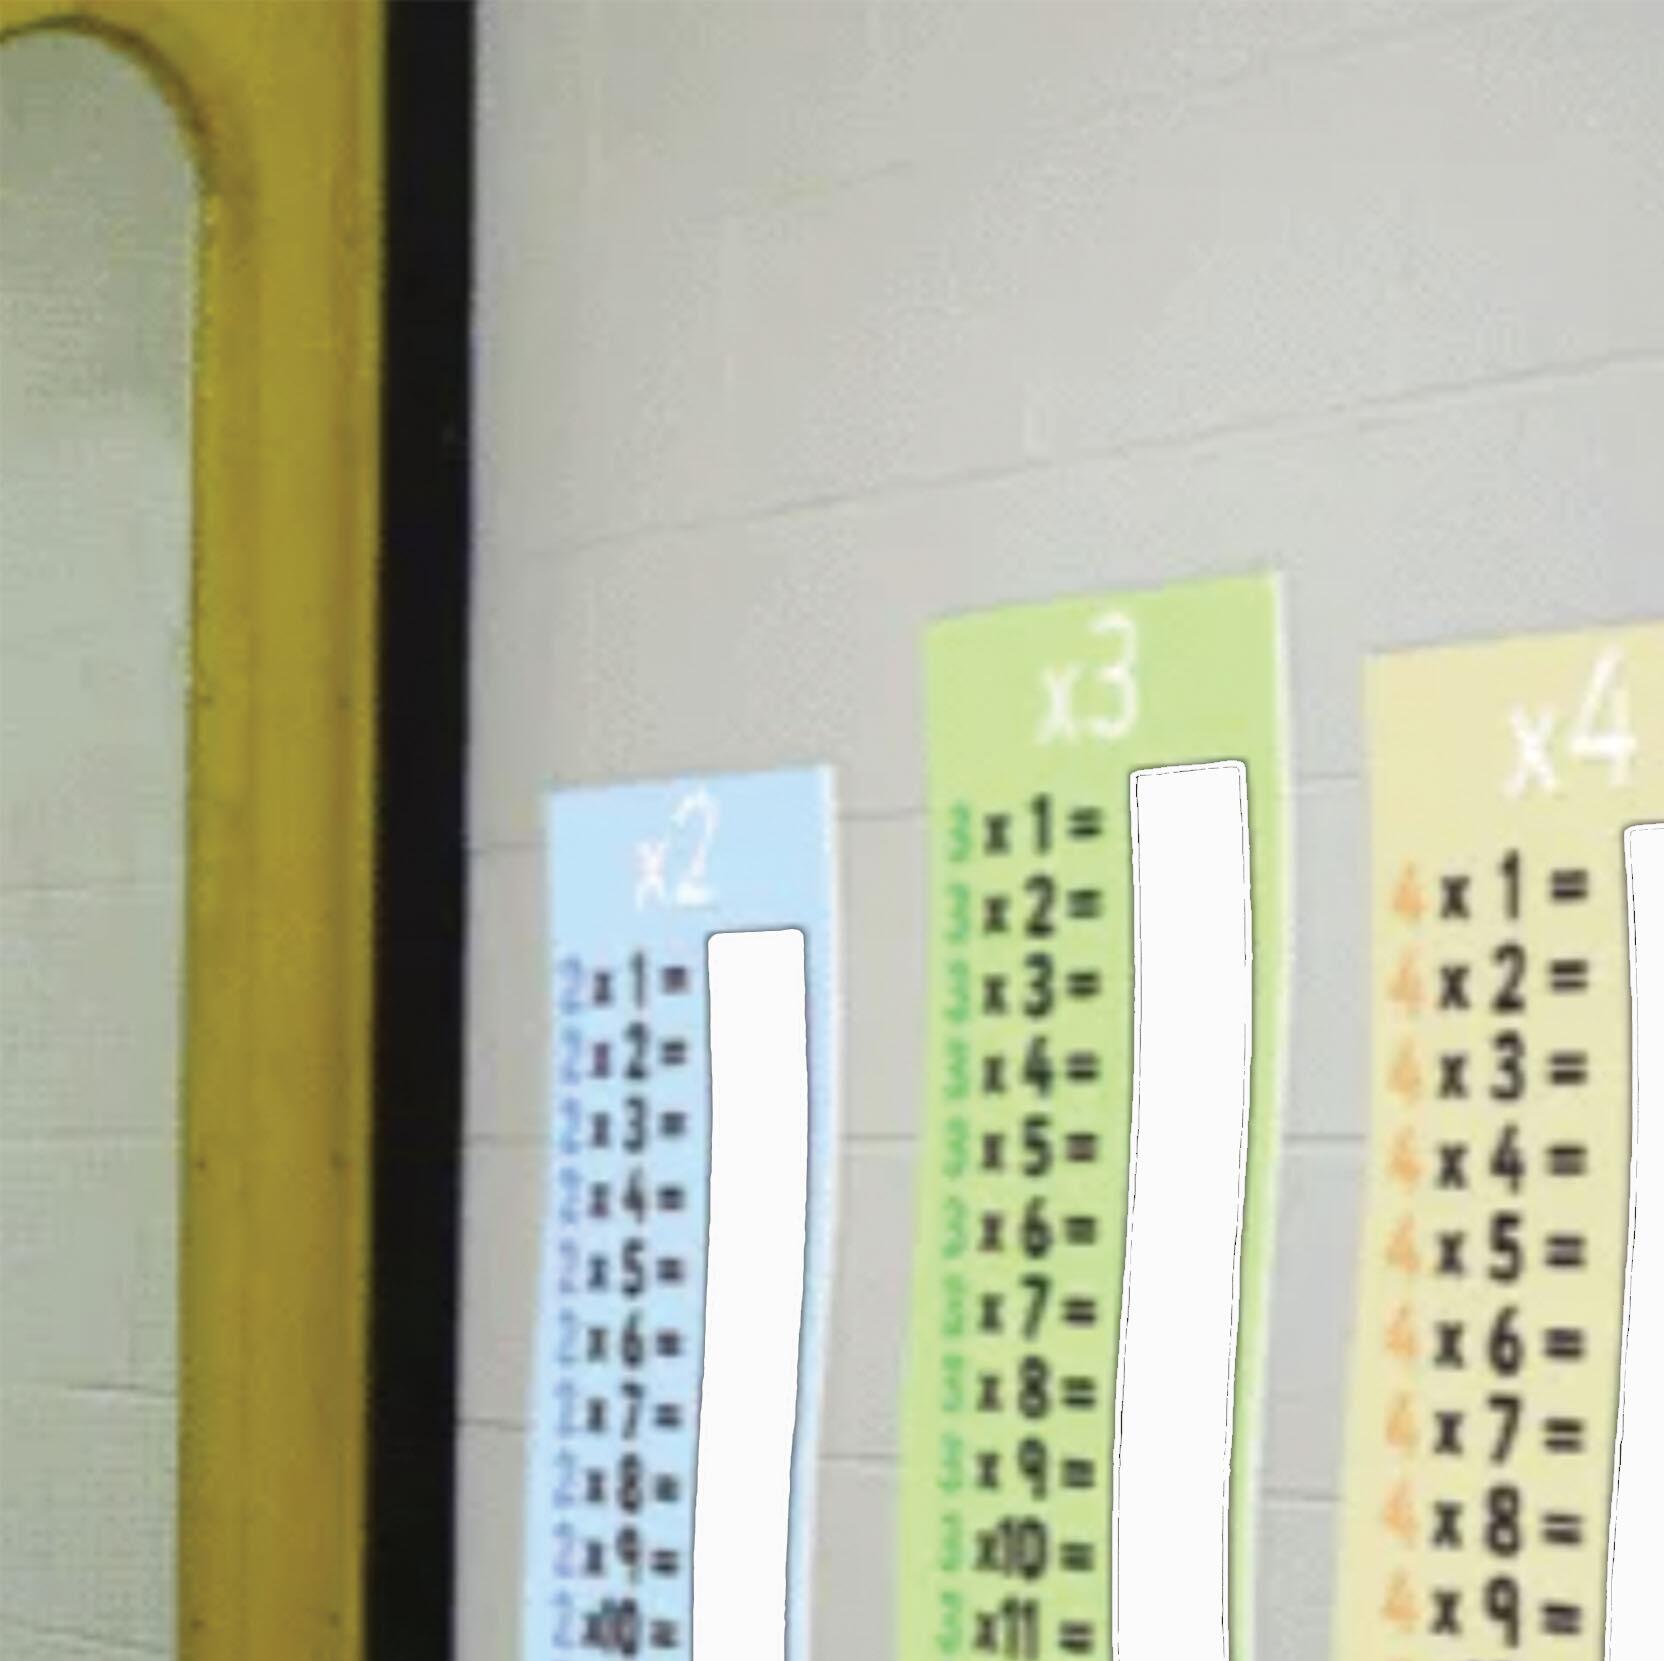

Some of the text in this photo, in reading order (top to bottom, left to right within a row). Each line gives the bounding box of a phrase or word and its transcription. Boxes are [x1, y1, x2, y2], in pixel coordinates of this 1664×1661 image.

[1038, 612, 1138, 744] x3
[1505, 645, 1639, 794] x4
[1029, 793, 1052, 855] 1
[1024, 874, 1057, 940] 2
[1440, 875, 1470, 919] x
[1499, 849, 1521, 920] 1
[1023, 951, 1055, 1020] 3
[1439, 965, 1470, 1010] x
[1491, 942, 1526, 1015] 2
[1439, 1054, 1467, 1099] x
[1490, 1029, 1526, 1102] 3
[1022, 1113, 1053, 1178] 5
[1436, 1231, 1465, 1276] x
[1488, 1210, 1523, 1285] 5
[1017, 1355, 1051, 1421] 8
[1433, 1411, 1463, 1455] x
[1487, 1392, 1523, 1464] 7
[1432, 1501, 1463, 1549] x
[1483, 1484, 1522, 1559] 8
